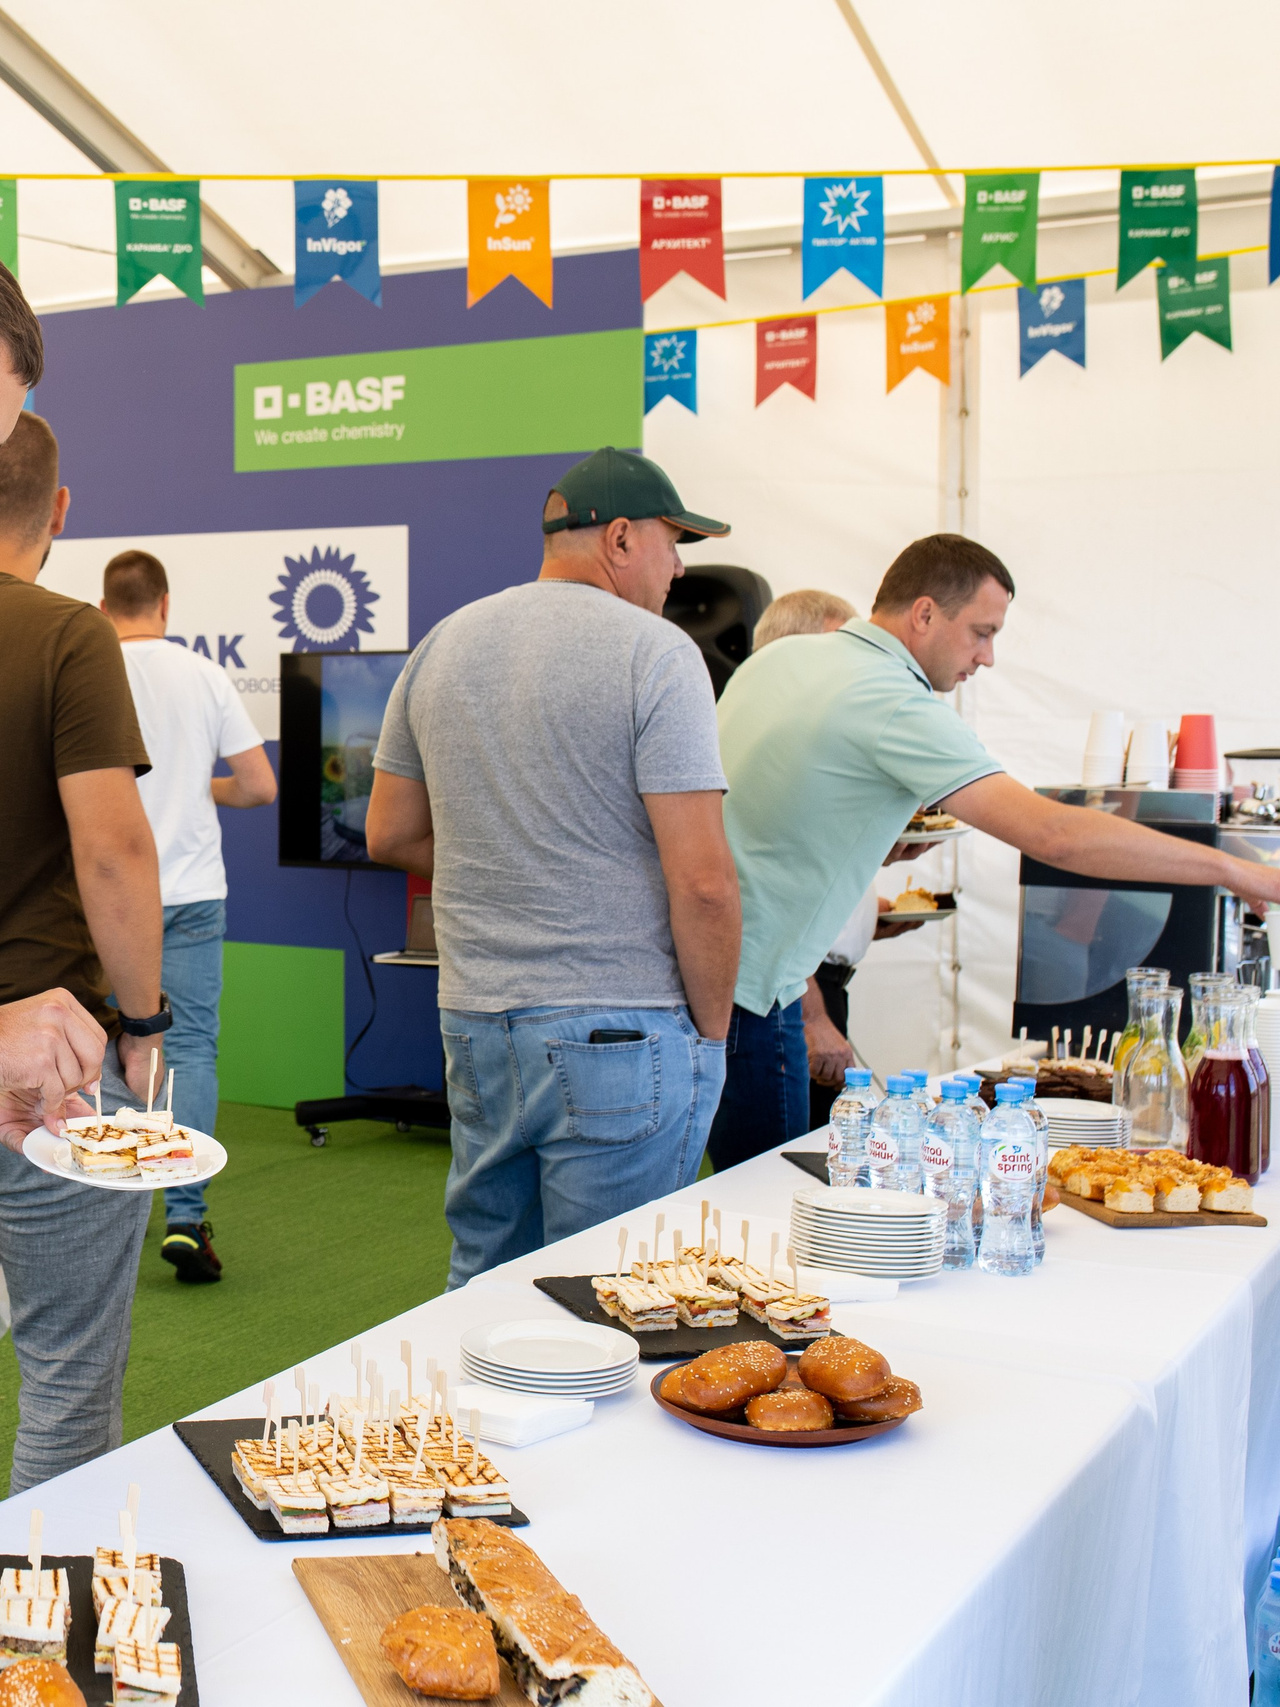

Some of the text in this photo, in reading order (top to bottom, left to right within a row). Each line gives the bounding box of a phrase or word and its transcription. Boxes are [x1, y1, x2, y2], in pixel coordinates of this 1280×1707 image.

[993, 189, 1027, 204] BASF
[1150, 184, 1186, 199] BASF
[148, 198, 187, 211] BASF
[671, 195, 709, 209] BASF
[306, 237, 362, 255] InVigor
[486, 236, 532, 251] InSun
[305, 375, 406, 416] BASF
[254, 421, 405, 446] We create chemistry
[164, 635, 246, 669] АК
[232, 678, 281, 694] ОВОЕ
[1001, 1153, 1031, 1163] saint
[997, 1163, 1033, 1175] spring
